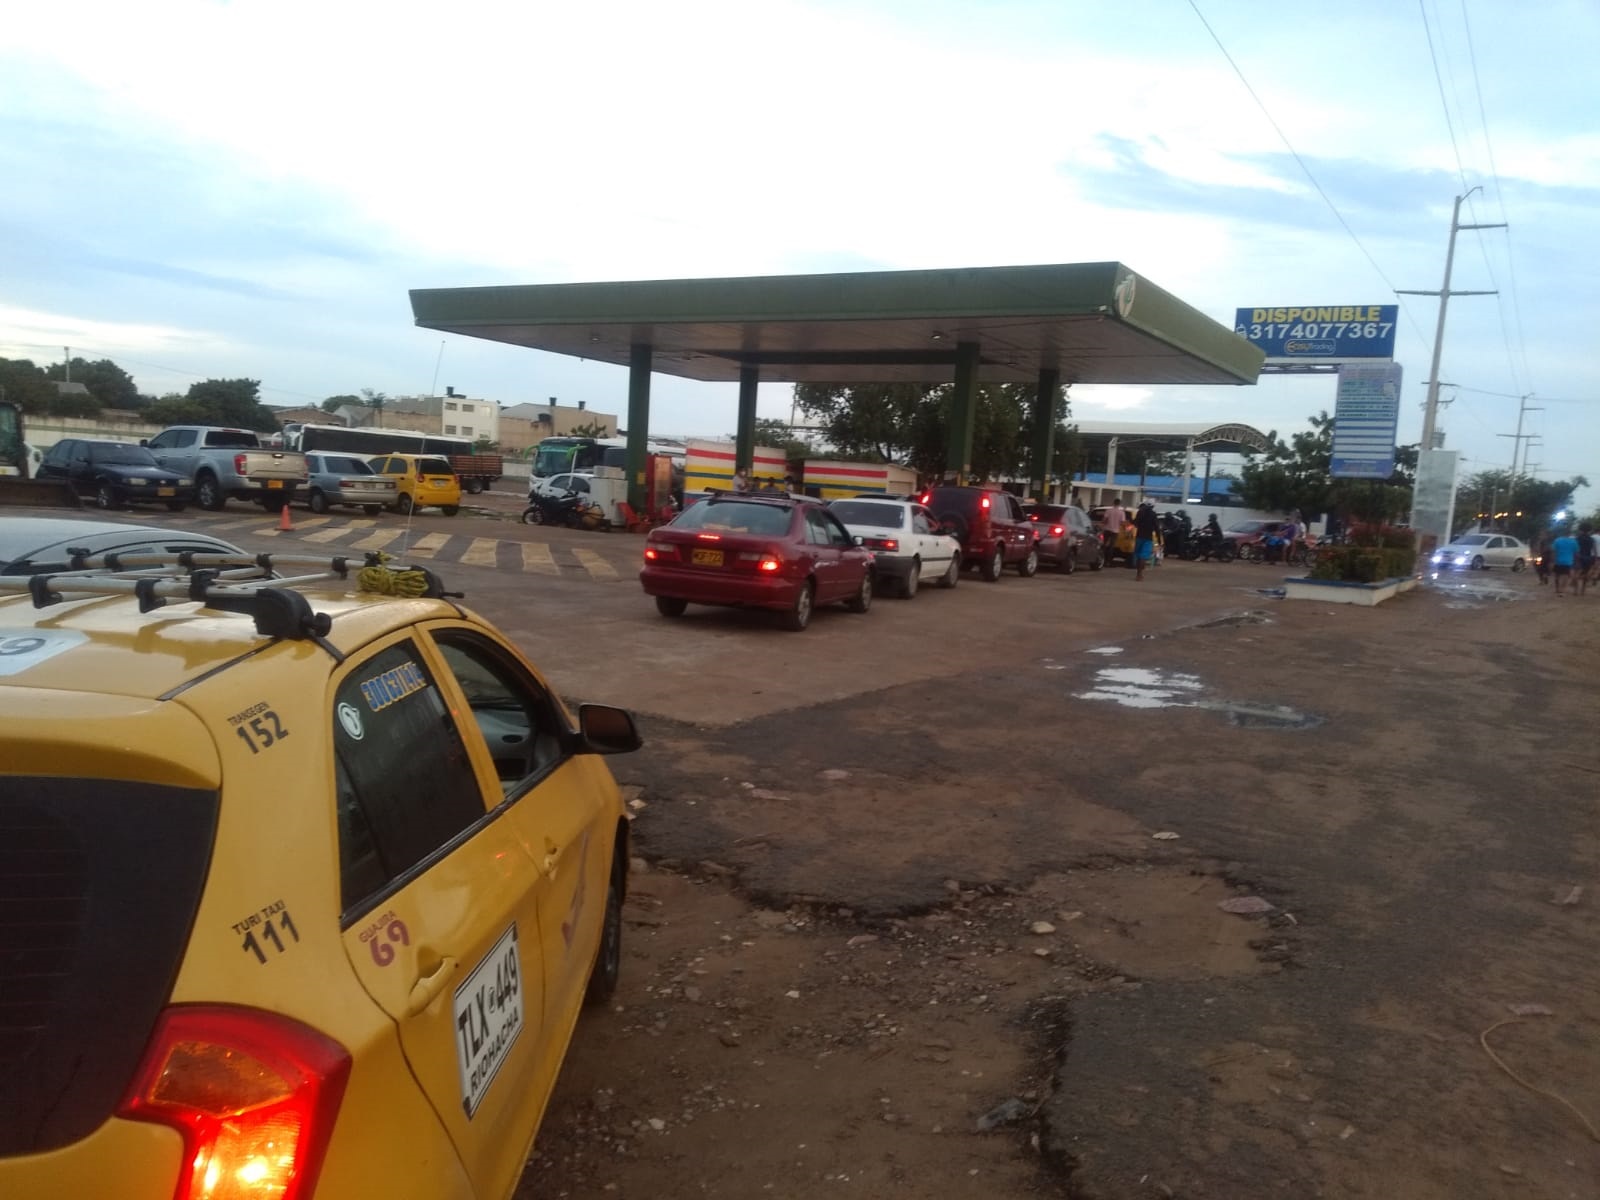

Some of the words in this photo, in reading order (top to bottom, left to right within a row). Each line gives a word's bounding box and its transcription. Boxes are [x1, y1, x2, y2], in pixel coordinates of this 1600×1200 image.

[1249, 323, 1392, 340] 3174077367
[1252, 306, 1382, 323] DISPONIBLE
[237, 710, 289, 754] 152
[231, 913, 261, 935] TURI
[261, 899, 286, 918] TAXI
[242, 910, 300, 965] 111
[370, 920, 410, 967] 69
[468, 1009, 520, 1097] RIOHACHA
